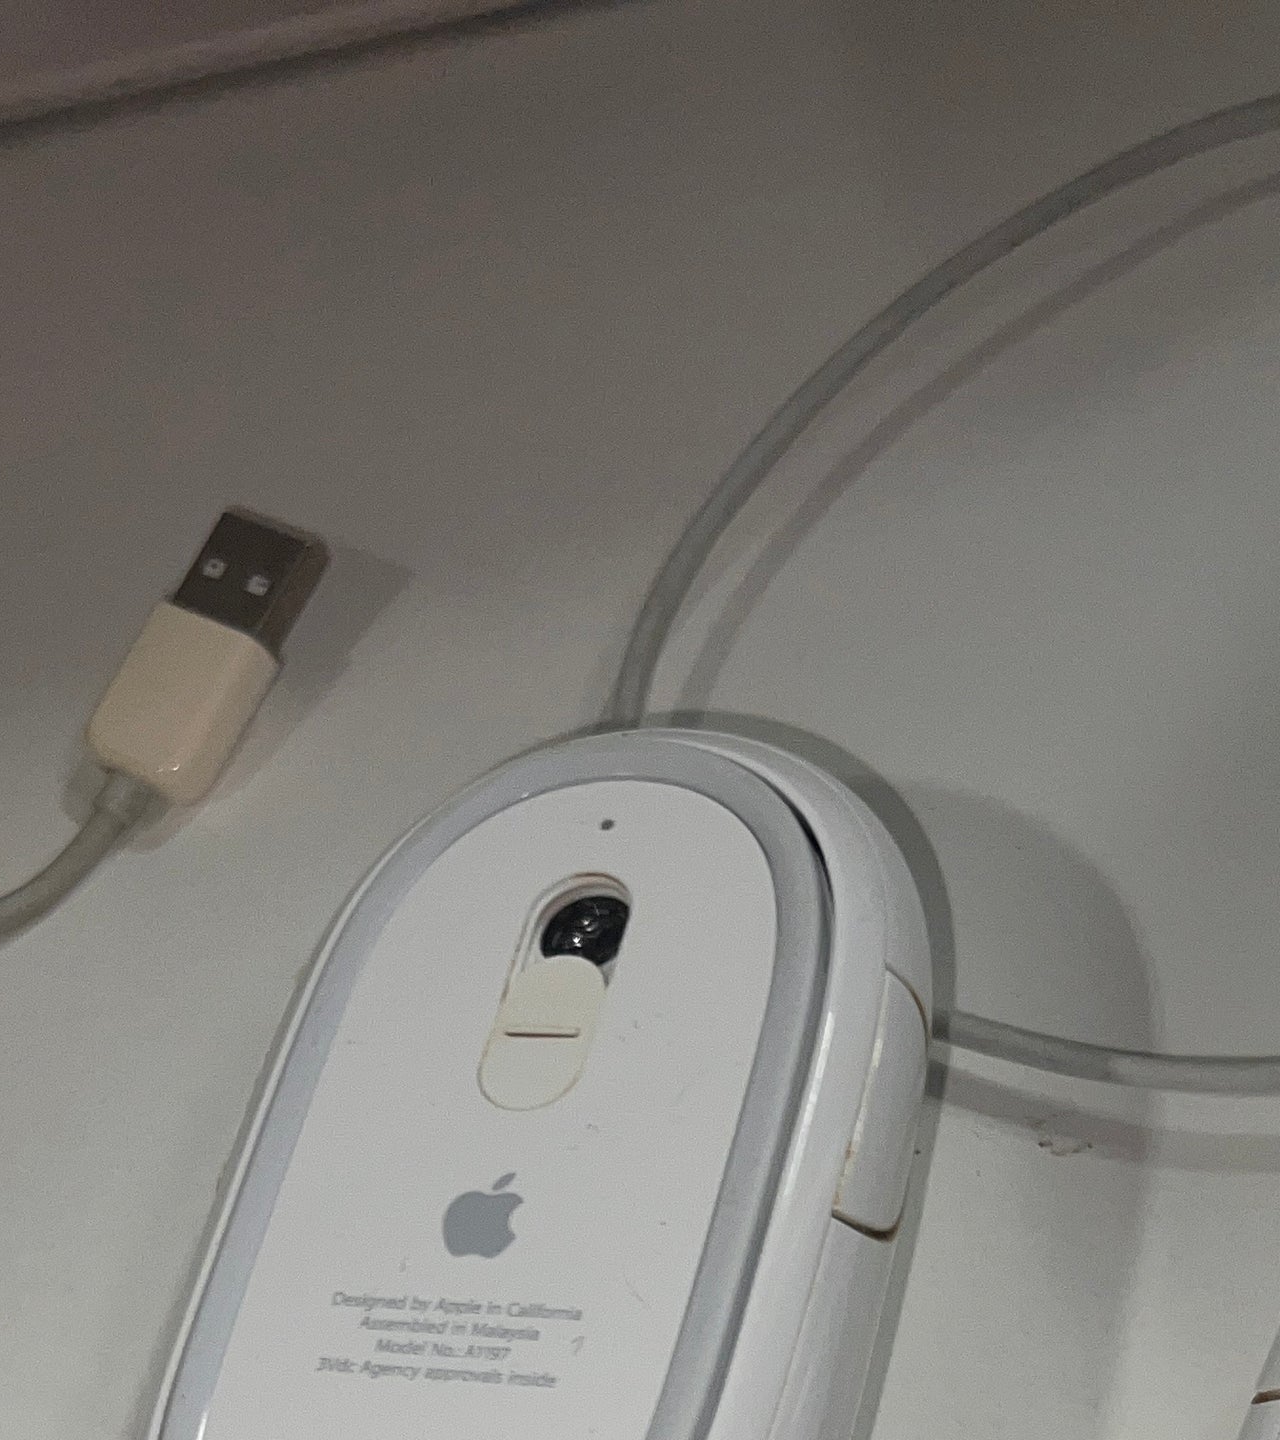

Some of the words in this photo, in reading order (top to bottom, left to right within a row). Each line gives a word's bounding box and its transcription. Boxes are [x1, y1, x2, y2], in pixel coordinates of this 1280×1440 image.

[332, 1292, 406, 1311] Designed
[410, 1296, 432, 1311] by
[435, 1298, 481, 1315] Apple
[487, 1301, 502, 1314] in
[508, 1302, 582, 1320] California
[360, 1316, 448, 1334] Assembled
[471, 1323, 540, 1342] Malaysia
[374, 1339, 425, 1355] Model
[360, 1360, 420, 1380] Agency
[424, 1367, 502, 1384] approvals
